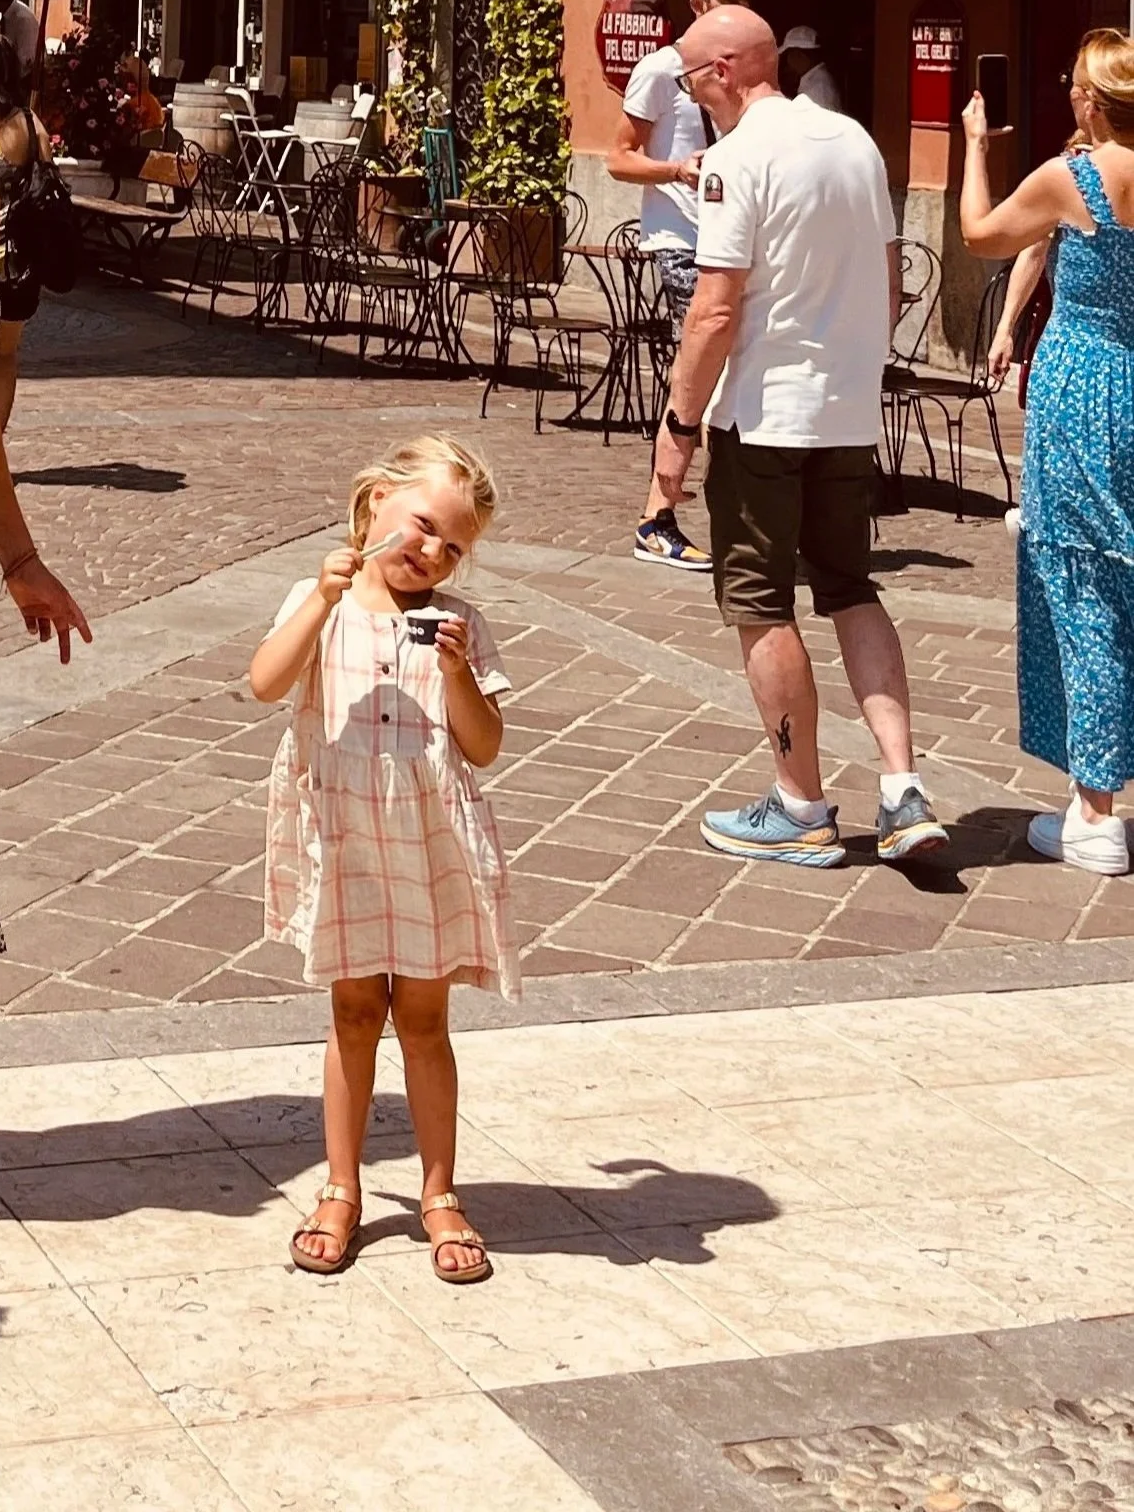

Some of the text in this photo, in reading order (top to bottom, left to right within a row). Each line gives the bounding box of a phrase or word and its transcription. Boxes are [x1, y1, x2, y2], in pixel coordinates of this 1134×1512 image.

[602, 13, 663, 37] LA FABBRICA
[912, 26, 923, 41] LA
[605, 39, 620, 61] DEL
[916, 44, 930, 60] DEL
